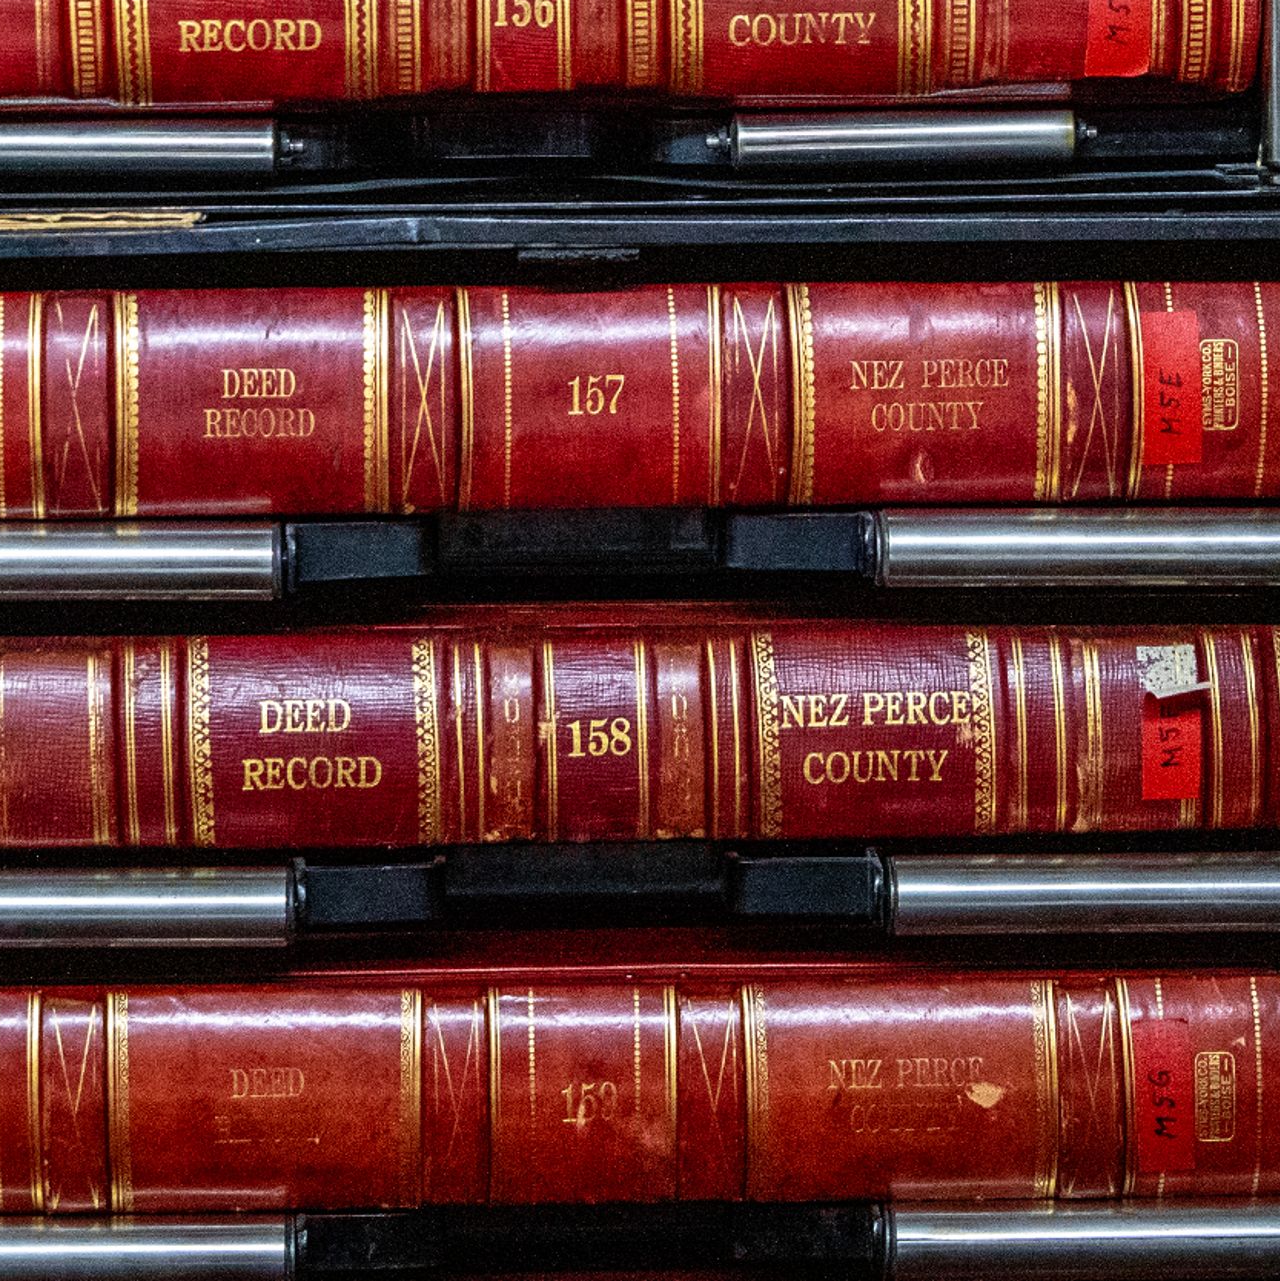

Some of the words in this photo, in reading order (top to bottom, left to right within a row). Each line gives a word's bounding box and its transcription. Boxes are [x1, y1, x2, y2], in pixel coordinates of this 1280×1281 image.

[179, 18, 322, 52] RECORD
[728, 13, 877, 46] COUNTY
[220, 368, 297, 399] DEED
[850, 360, 905, 390] NEZ
[920, 358, 1009, 388] PERCE
[1225, 362, 1236, 407] BOISE
[567, 375, 626, 415] 157
[202, 407, 316, 440] RECORD
[871, 400, 985, 432] COUNTY
[259, 699, 351, 734] DEED
[781, 695, 846, 729] NEZ
[861, 690, 972, 725] PERCE
[566, 718, 632, 758] 158
[242, 756, 382, 791] RECORD
[803, 750, 948, 785] COUNTY
[827, 1059, 883, 1090] NEZ
